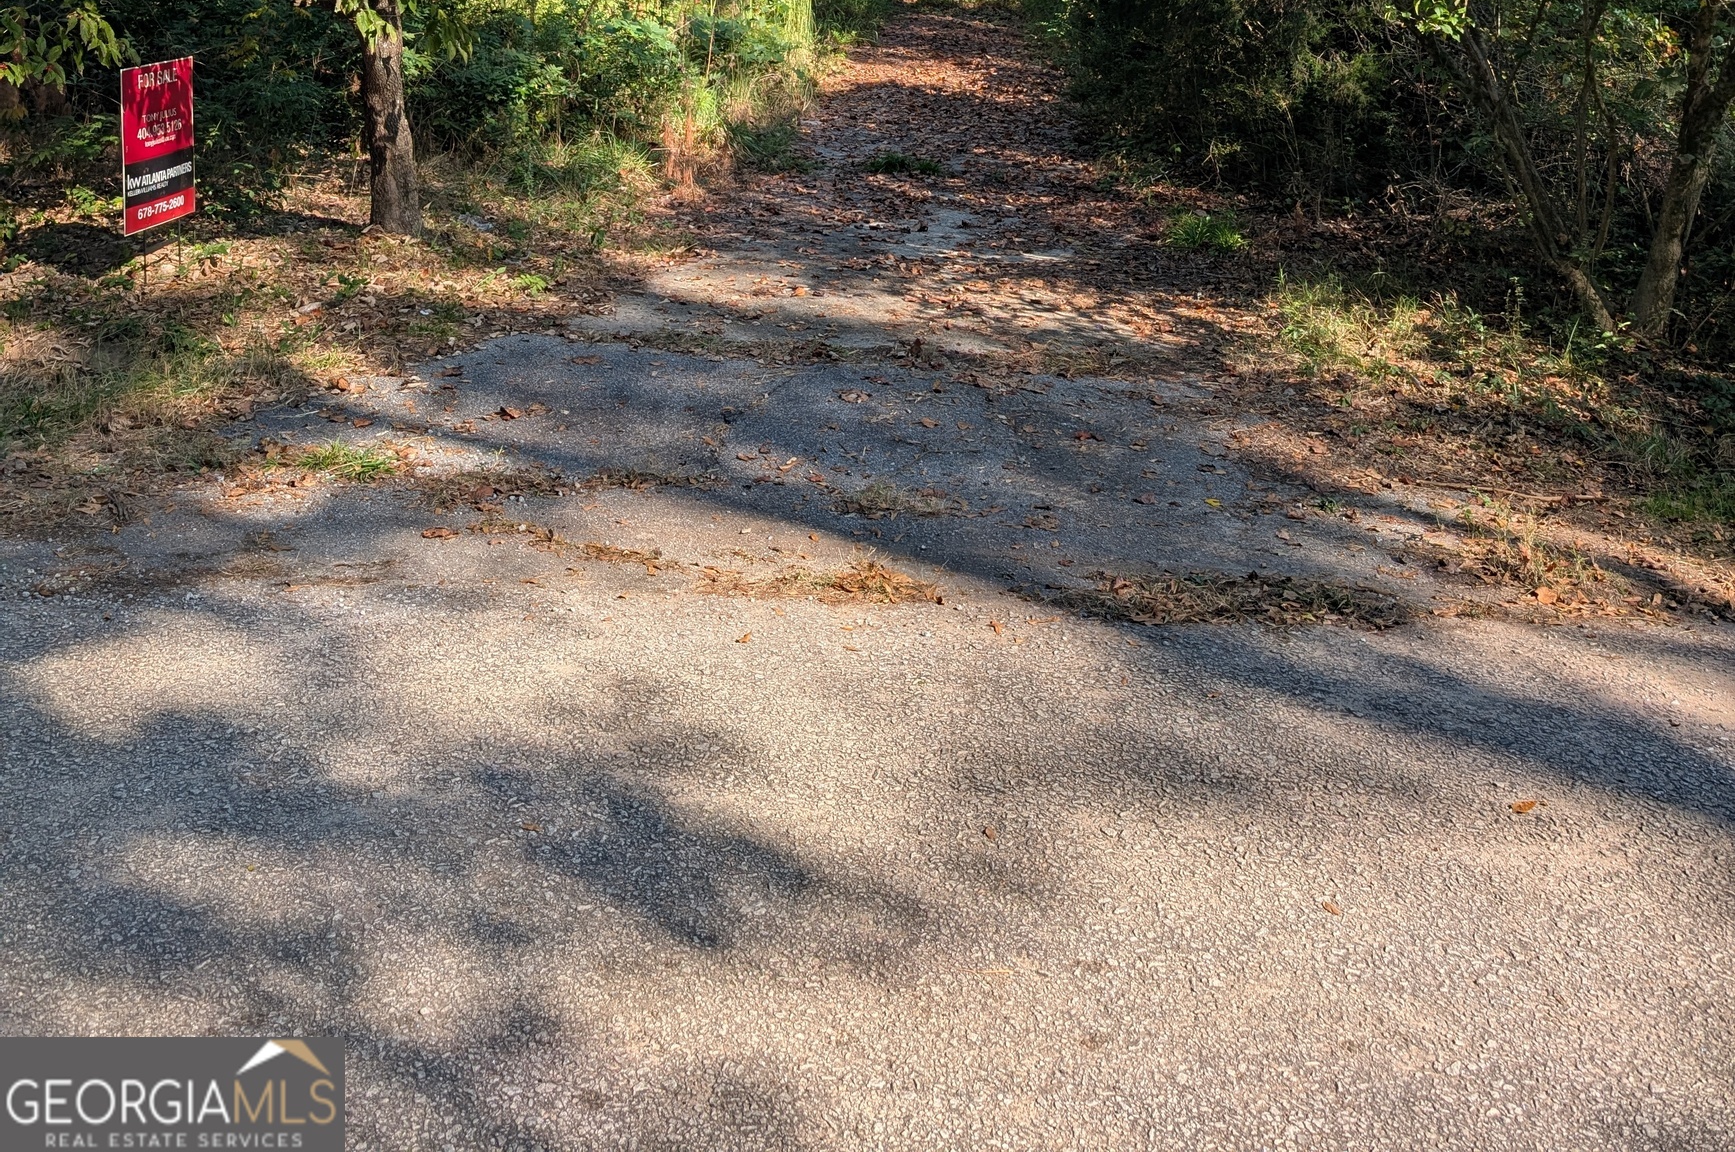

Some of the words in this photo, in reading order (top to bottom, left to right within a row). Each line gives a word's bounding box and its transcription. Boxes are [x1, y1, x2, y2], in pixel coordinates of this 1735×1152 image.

[137, 72, 155, 89] FOR
[157, 68, 178, 85] SALE
[127, 174, 141, 190] kw
[141, 170, 167, 187] ATLANTA
[167, 161, 192, 179] PARTNERS
[137, 195, 185, 220] 678-775-2600
